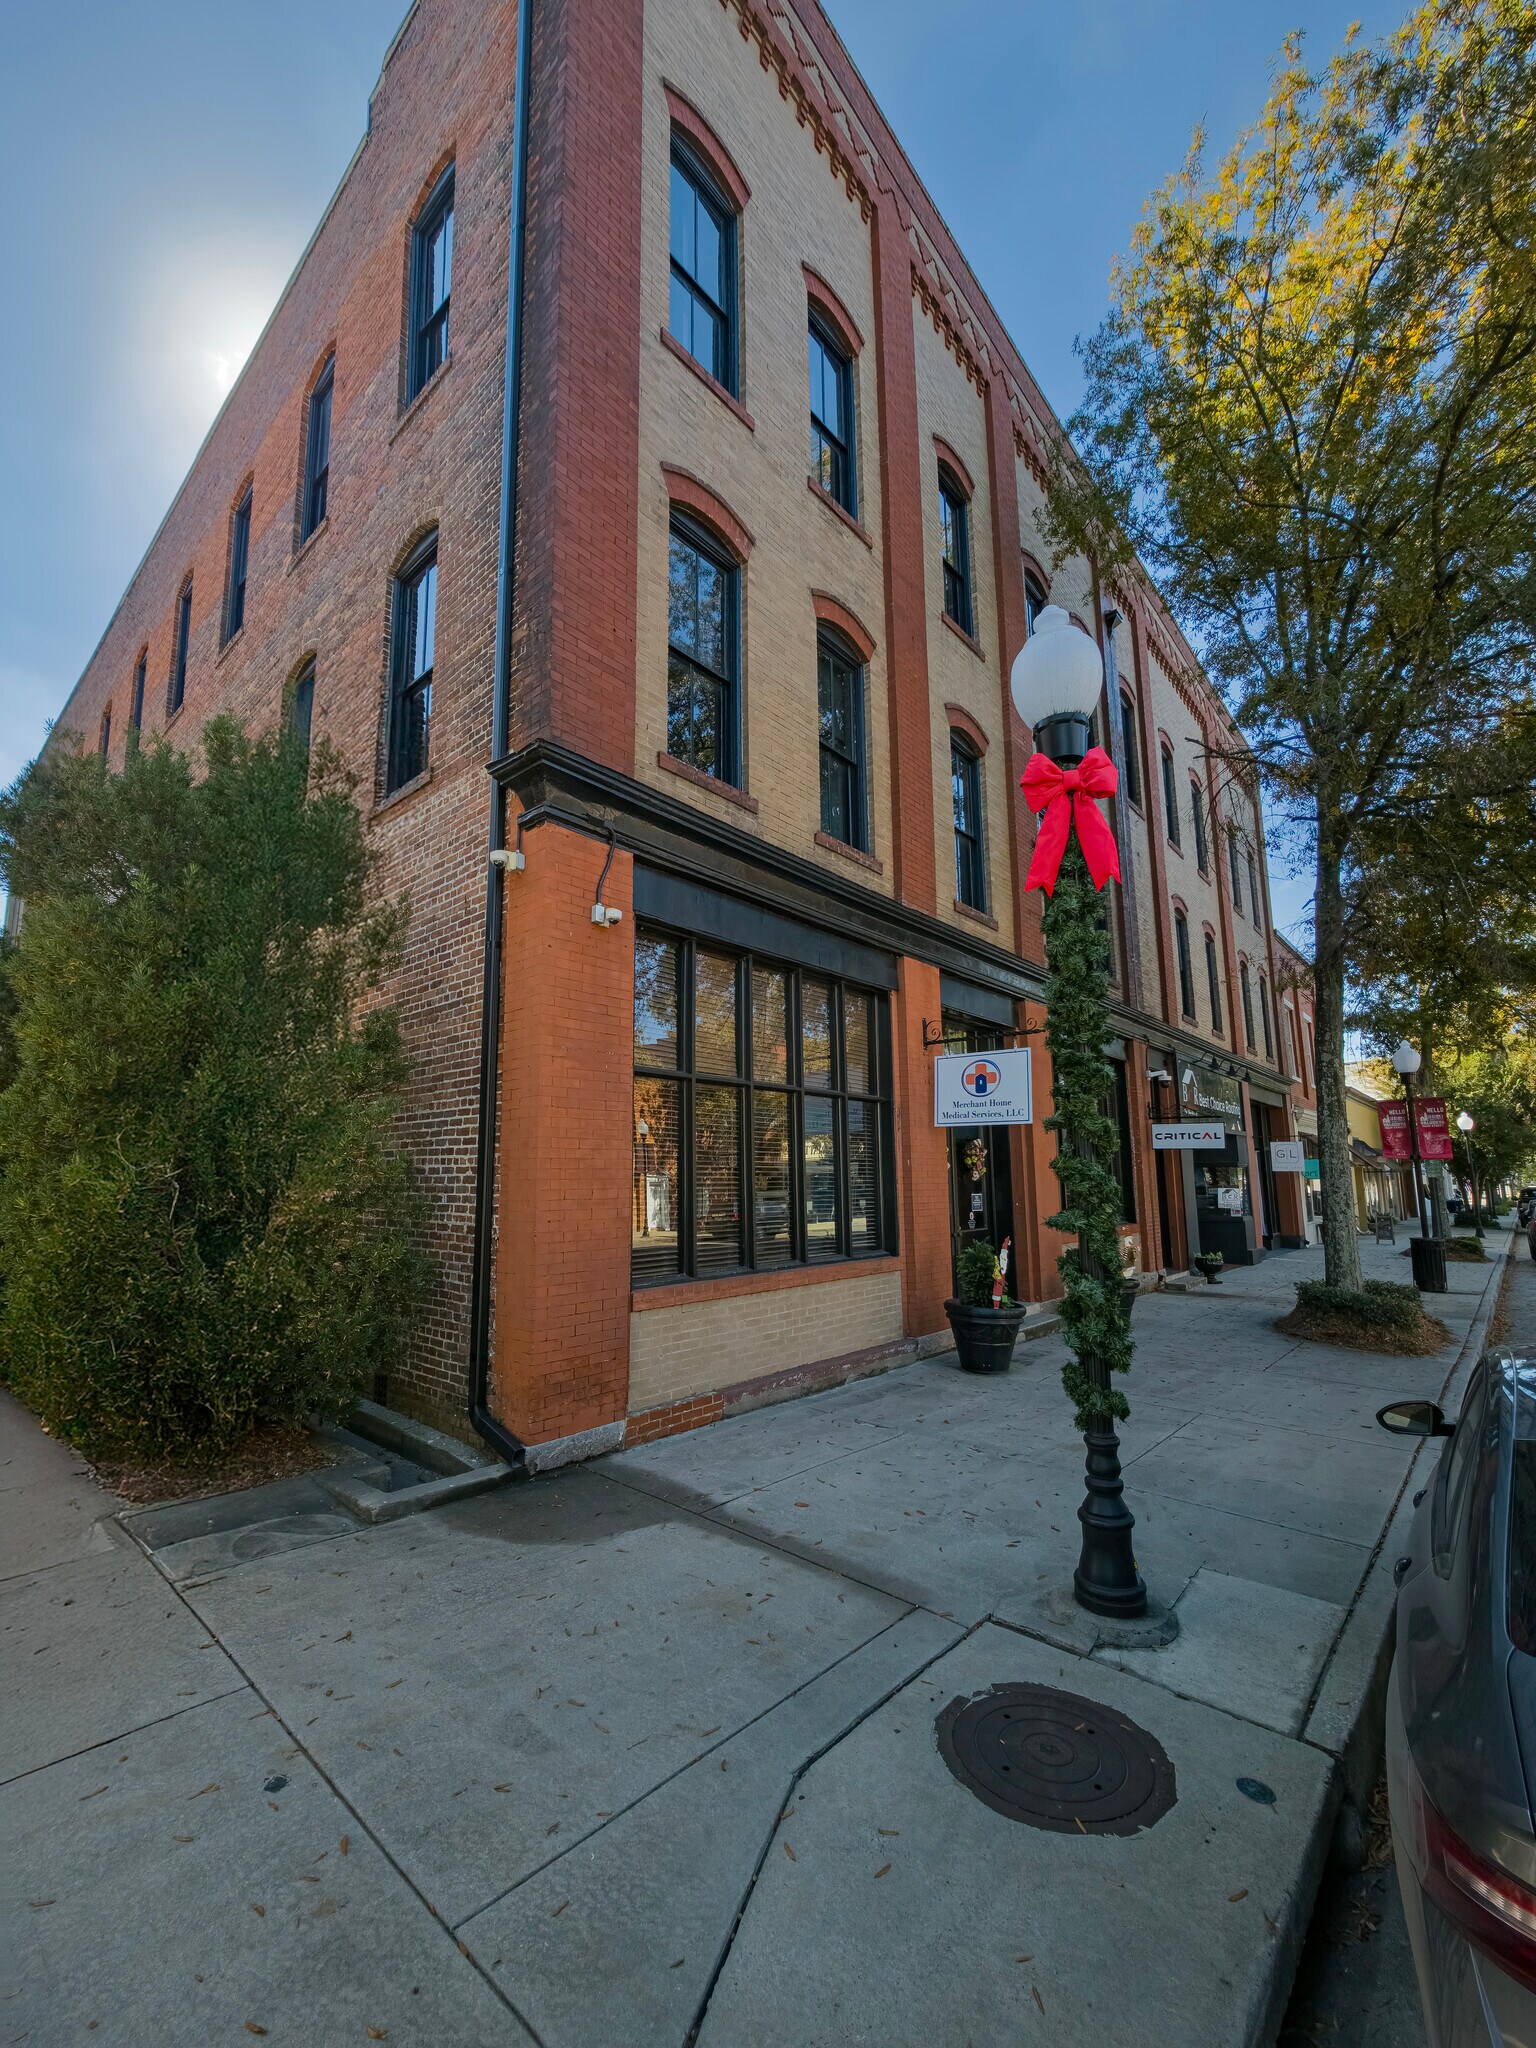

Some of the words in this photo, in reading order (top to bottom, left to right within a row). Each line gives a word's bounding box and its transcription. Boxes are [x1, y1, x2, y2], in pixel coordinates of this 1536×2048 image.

[953, 1100, 987, 1109] Merchant
[989, 1099, 1012, 1107] Home
[1199, 1093, 1209, 1108] Best
[1210, 1096, 1226, 1112] Choice
[1225, 1101, 1240, 1119] Roofing
[942, 1111, 970, 1119] Medical
[971, 1110, 1004, 1118] Services,
[1006, 1108, 1024, 1117] LLC
[1154, 1132, 1222, 1141] CRITICAL
